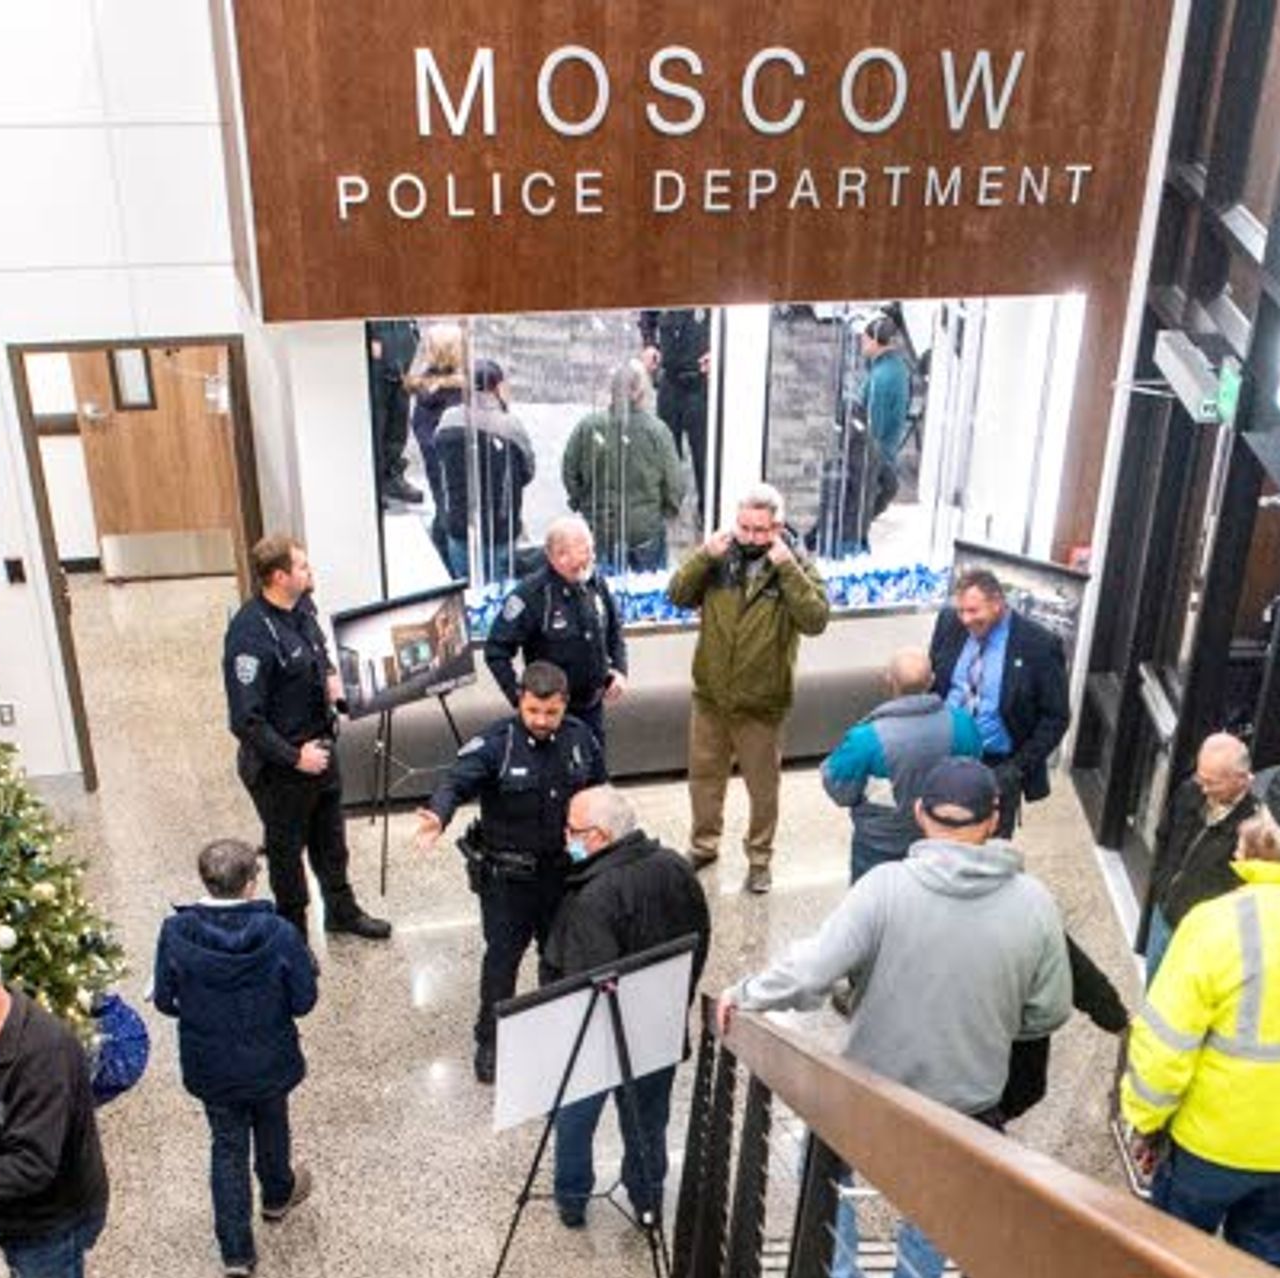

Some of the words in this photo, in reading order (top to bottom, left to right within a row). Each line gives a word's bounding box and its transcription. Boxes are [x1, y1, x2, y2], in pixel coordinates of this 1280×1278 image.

[412, 42, 1027, 138] MOSCOW
[335, 170, 605, 221] POLICE
[652, 162, 1094, 215] DEPARTMENT
